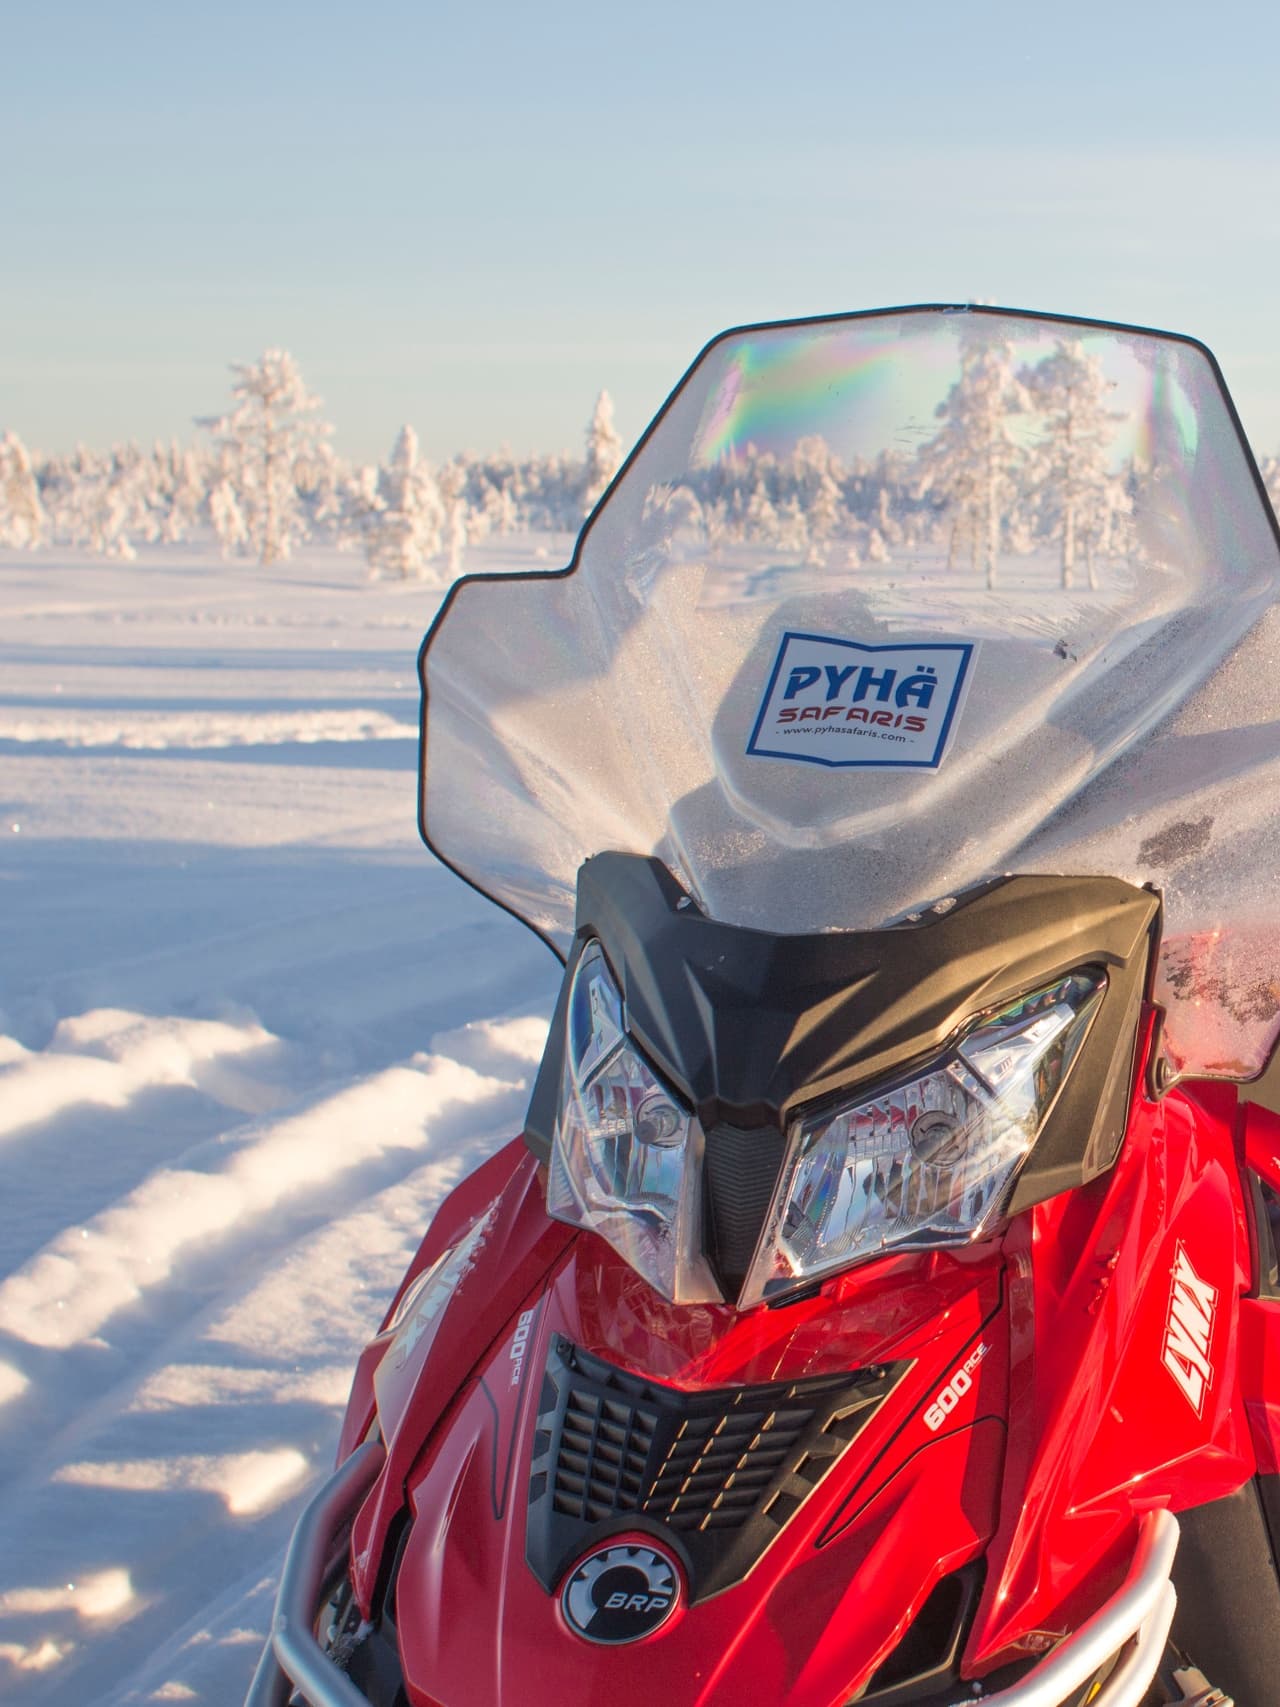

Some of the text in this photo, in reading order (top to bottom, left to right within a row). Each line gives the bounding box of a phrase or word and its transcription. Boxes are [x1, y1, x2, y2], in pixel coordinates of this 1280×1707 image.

[783, 665, 938, 709] PYHÄ
[776, 706, 927, 732] SAFARIS
[783, 725, 906, 743] www.pyhasafaris.com
[1162, 1241, 1219, 1416] LYNX
[604, 1592, 669, 1613] BRP
